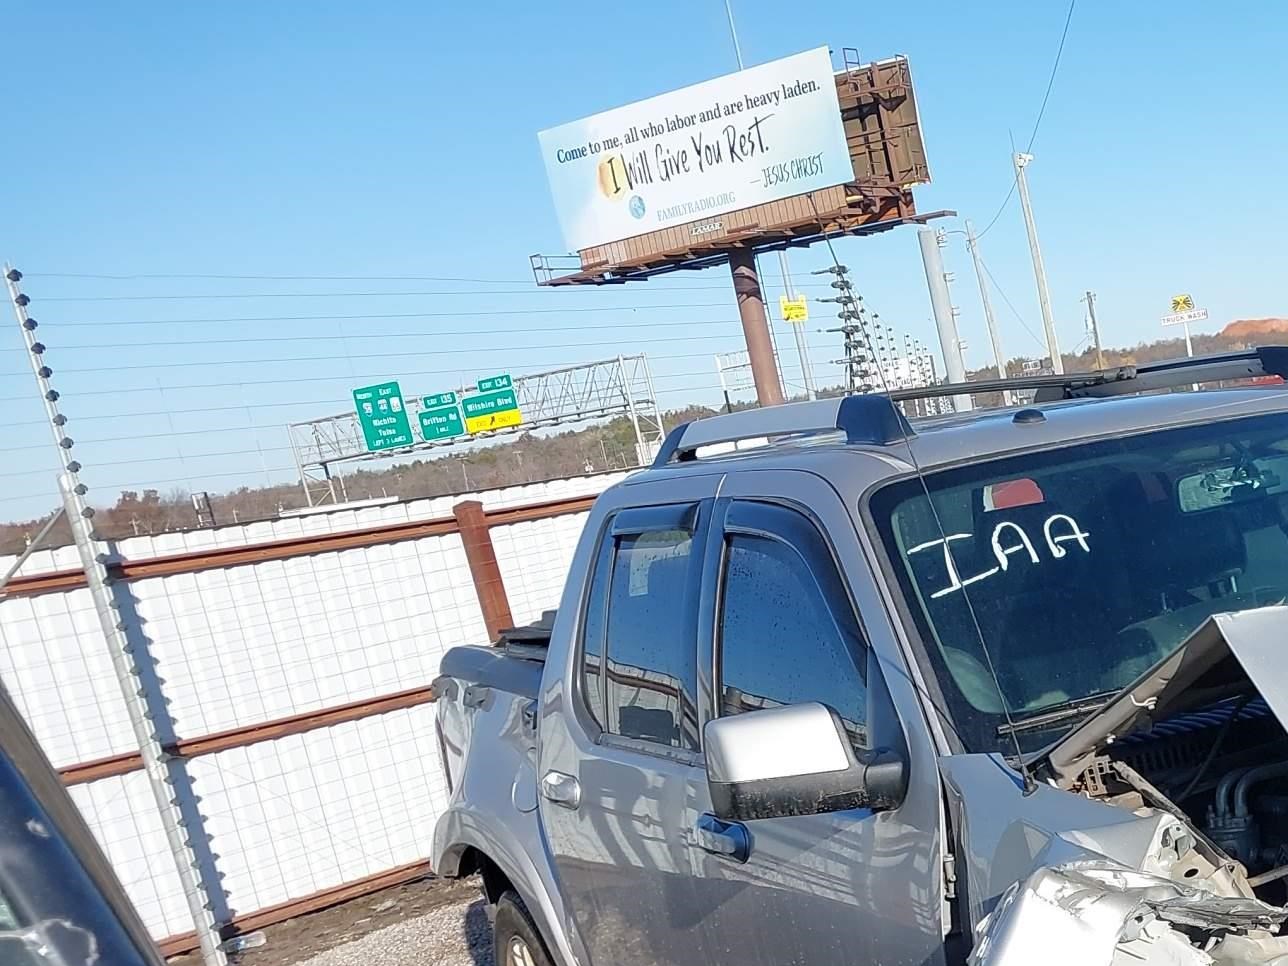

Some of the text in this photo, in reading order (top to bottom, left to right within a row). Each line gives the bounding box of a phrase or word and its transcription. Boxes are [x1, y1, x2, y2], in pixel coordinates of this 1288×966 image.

[557, 79, 821, 164] Come to me, all who labor and are heavy laden.
[607, 113, 775, 195] I Will Give You Rest.
[790, 151, 825, 180] CHRIST
[1162, 311, 1207, 324] TRUCK WASH
[467, 400, 495, 412] Wilshire
[372, 416, 396, 426] Wichita
[423, 415, 447, 426] Britton
[907, 514, 1090, 598] IAA
